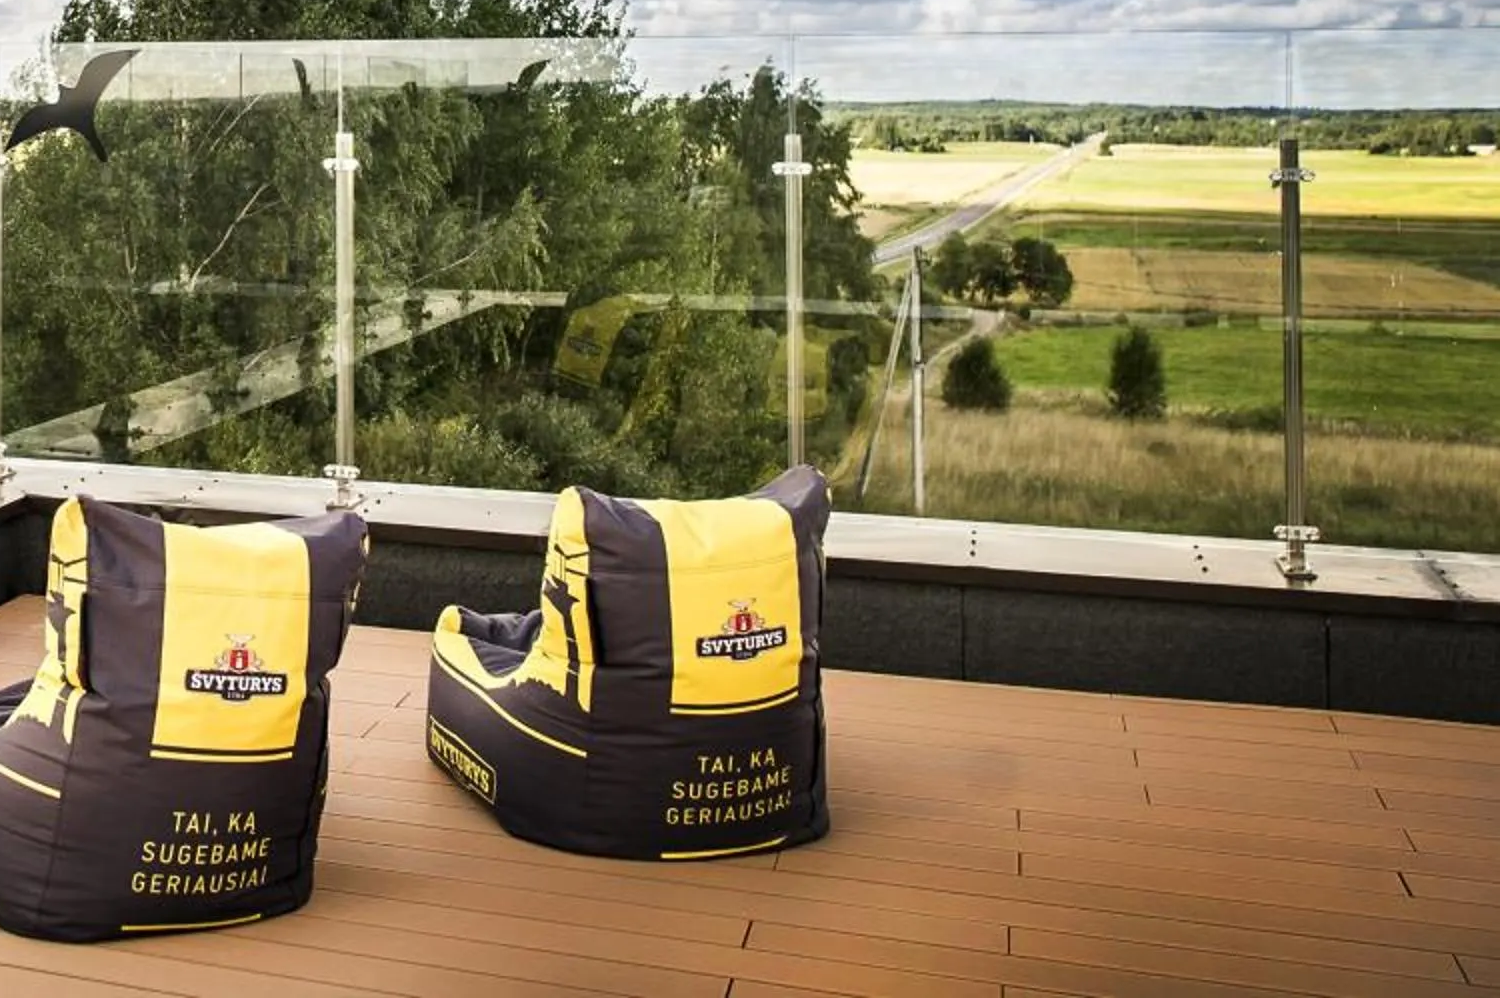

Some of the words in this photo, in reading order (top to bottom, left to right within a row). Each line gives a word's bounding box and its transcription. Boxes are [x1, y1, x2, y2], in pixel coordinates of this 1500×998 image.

[672, 765, 791, 799] SUGEBAME
[141, 837, 272, 865] SUGEBAME
[131, 865, 268, 895] GERIAUSIAI
